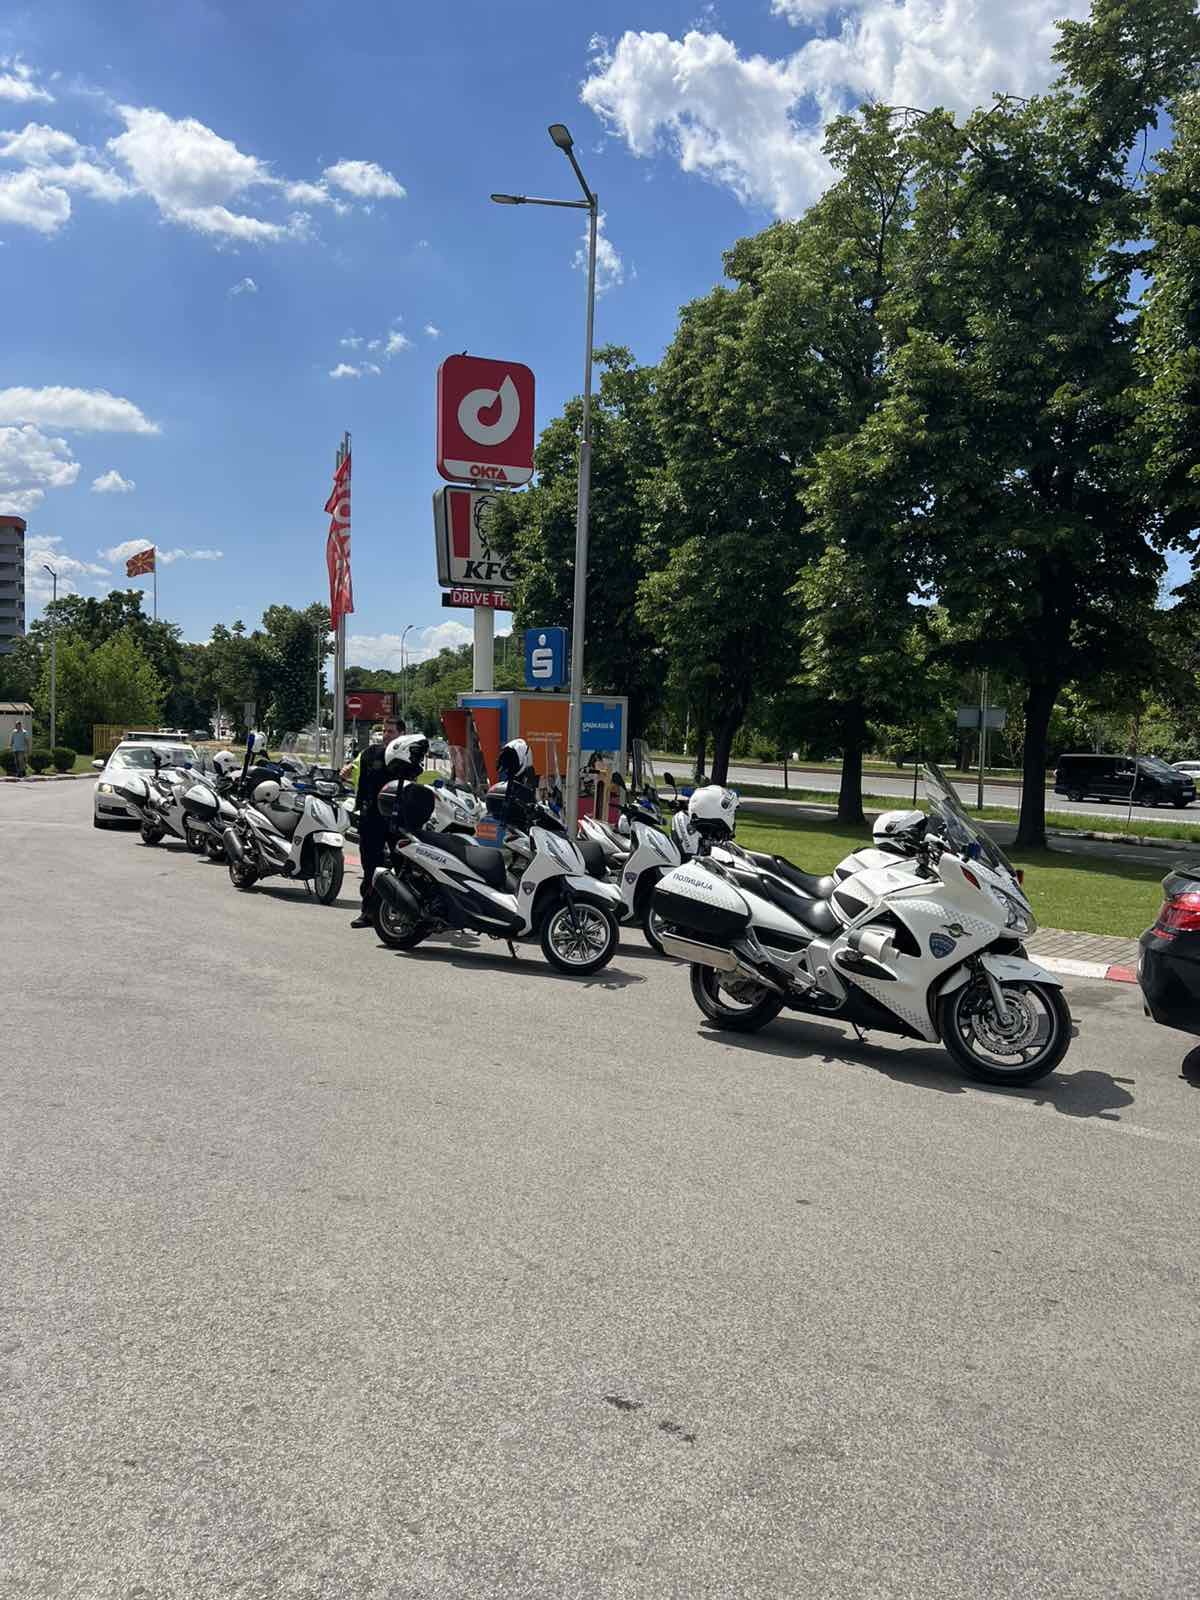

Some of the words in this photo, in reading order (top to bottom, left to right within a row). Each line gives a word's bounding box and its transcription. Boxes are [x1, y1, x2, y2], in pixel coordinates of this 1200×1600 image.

[470, 465, 508, 480] OKTA
[463, 560, 520, 581] KFC
[452, 591, 489, 605] DRIVE
[672, 872, 713, 891] ПОЛИЦИЈА
